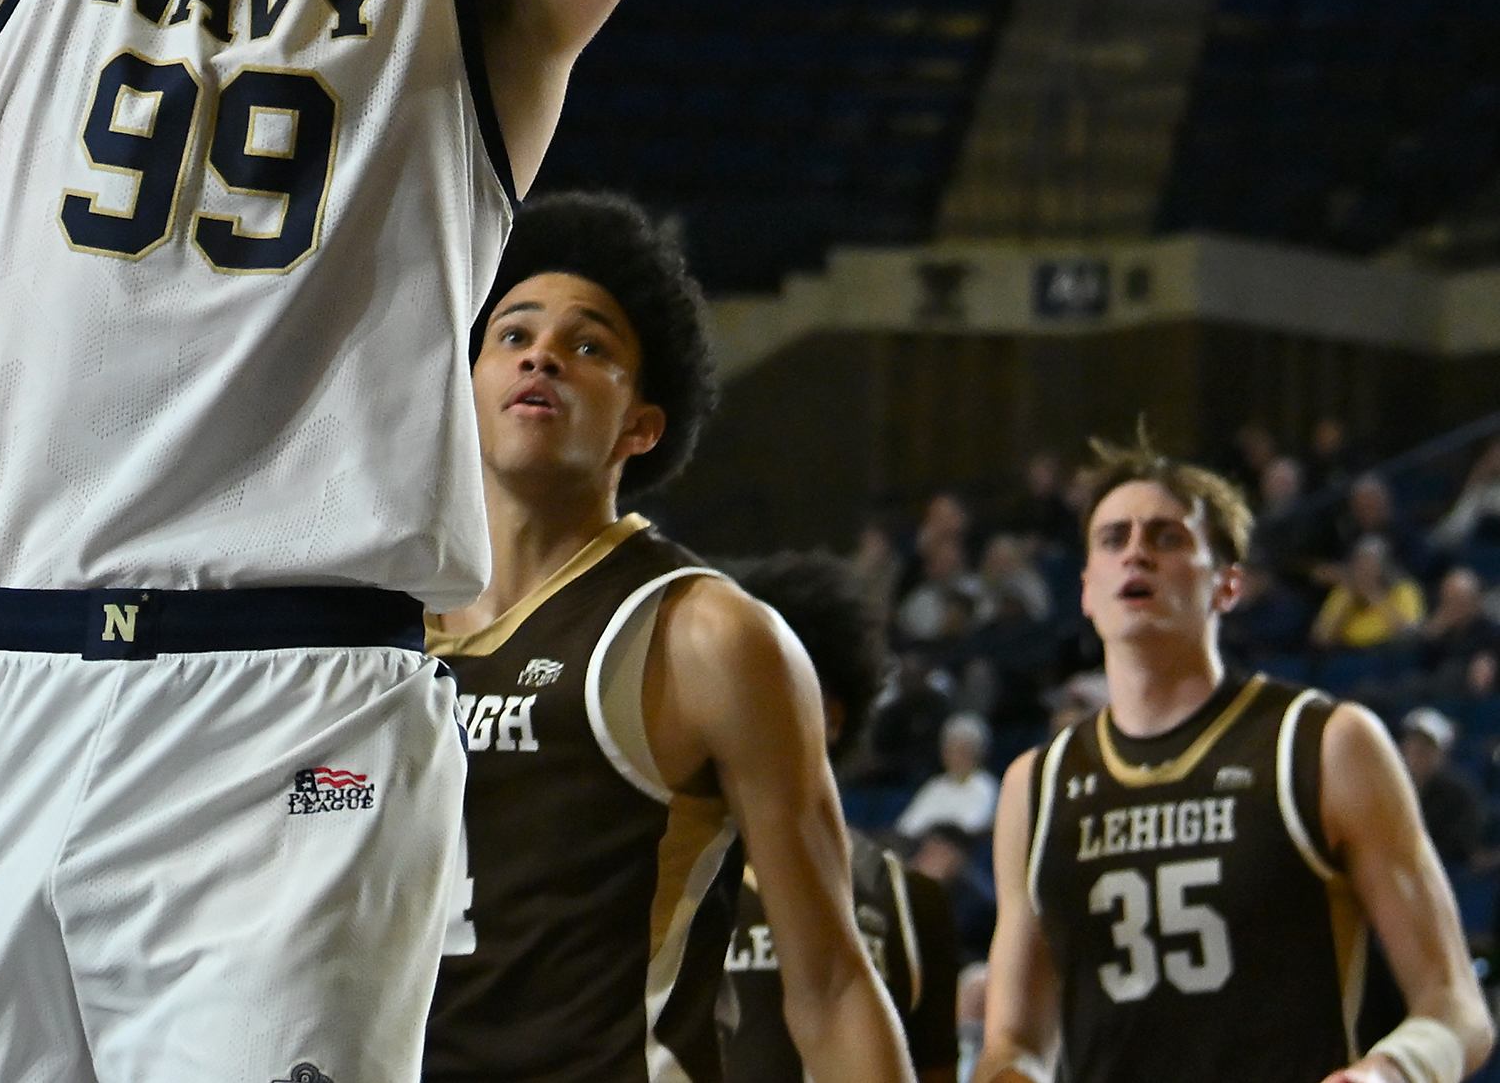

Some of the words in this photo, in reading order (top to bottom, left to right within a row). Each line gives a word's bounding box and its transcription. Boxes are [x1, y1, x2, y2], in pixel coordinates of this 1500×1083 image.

[58, 47, 341, 274] 99
[101, 603, 138, 642] N
[288, 784, 375, 804] PATRIOT
[288, 799, 374, 815] LEAGUE
[1077, 798, 1236, 862] LEHIGH
[1089, 857, 1234, 1004] 35
